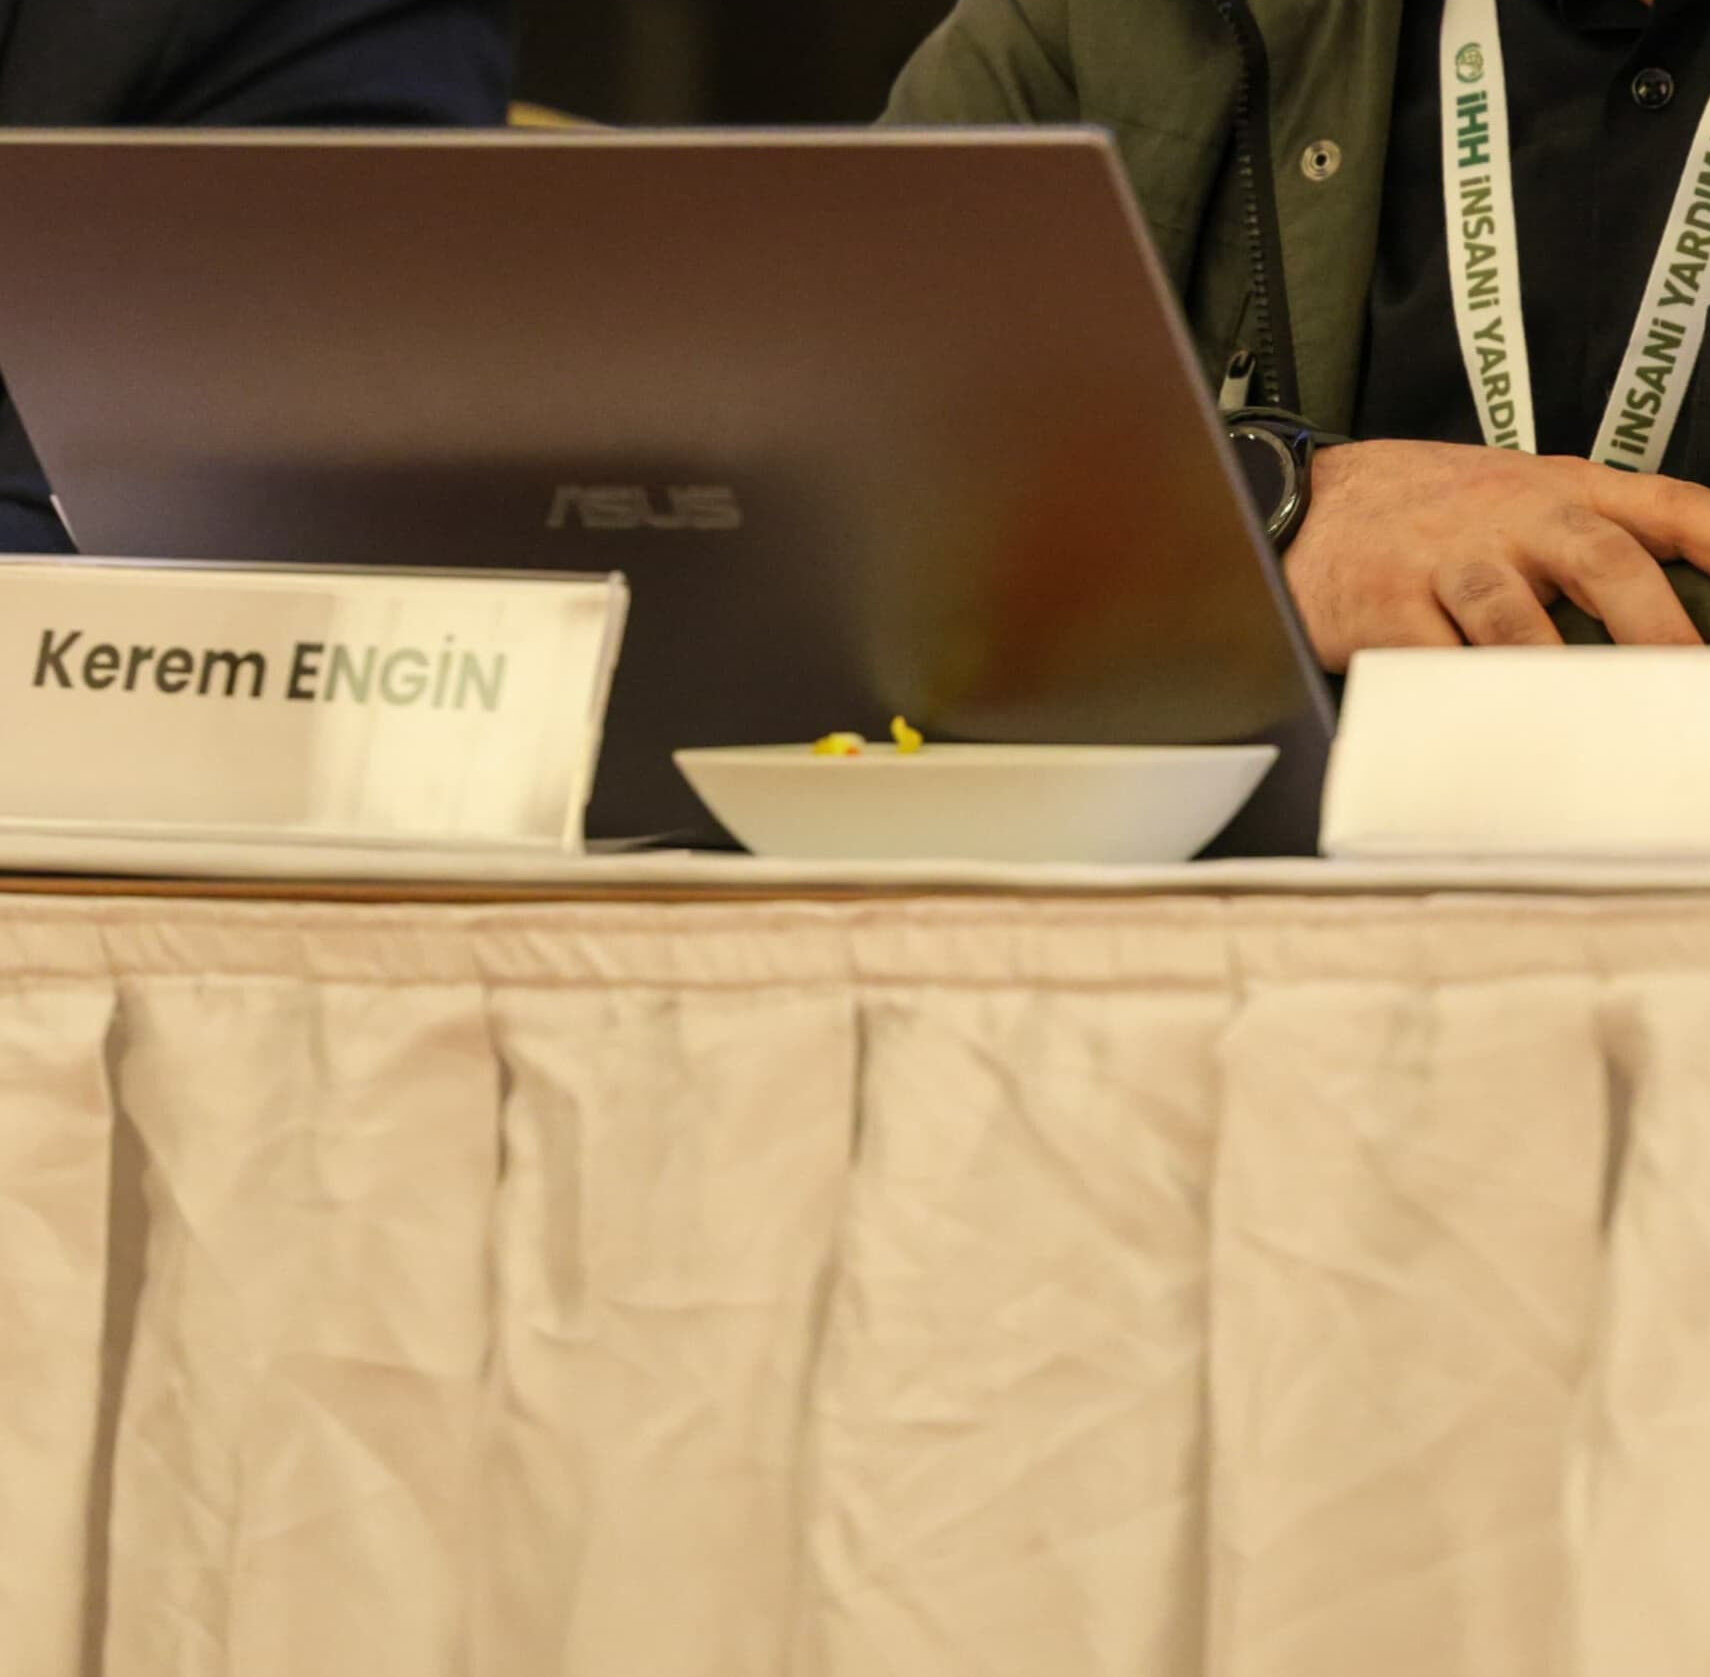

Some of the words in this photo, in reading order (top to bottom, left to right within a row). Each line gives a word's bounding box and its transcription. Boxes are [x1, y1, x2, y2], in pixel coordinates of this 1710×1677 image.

[545, 484, 742, 531] ASUS
[32, 629, 267, 699] Kerem
[285, 634, 508, 712] ENGİN
